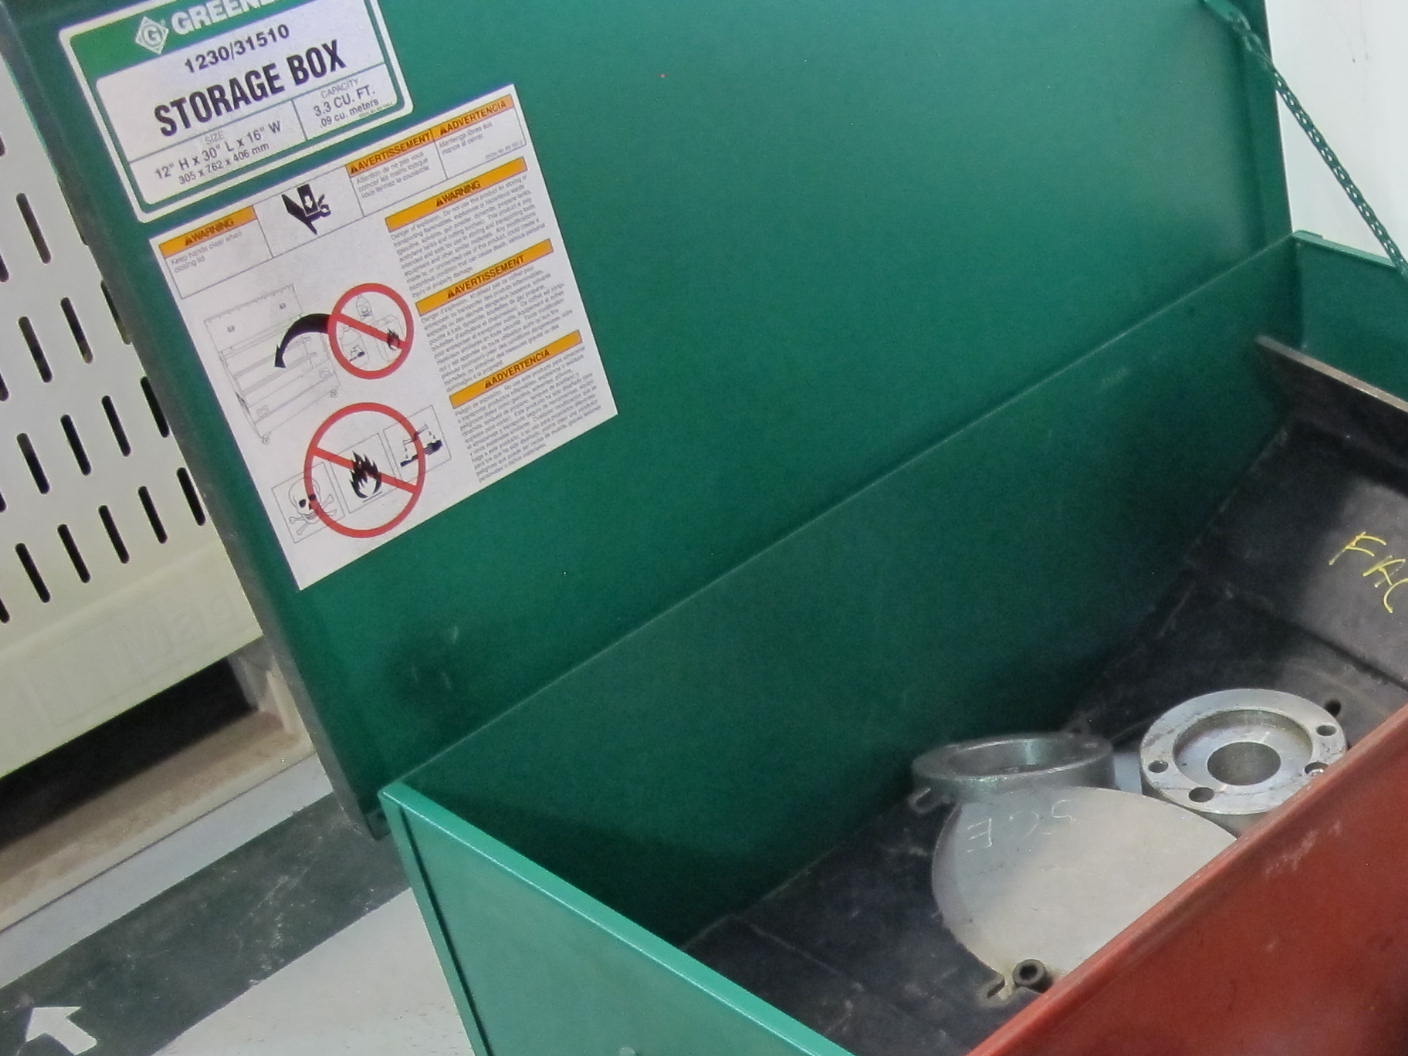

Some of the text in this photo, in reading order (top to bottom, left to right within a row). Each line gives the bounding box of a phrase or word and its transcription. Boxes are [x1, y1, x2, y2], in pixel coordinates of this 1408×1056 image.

[171, 0, 274, 35] GREEN
[184, 23, 290, 73] 1230/31510
[154, 39, 346, 137] STORAGE BOX
[313, 84, 376, 117] 3.3 CU. FT.
[321, 78, 358, 99] CAPACITY
[349, 98, 379, 116] meters
[447, 101, 507, 131] ADVERTENCIA
[155, 163, 174, 179] 12"
[178, 157, 190, 170] H
[201, 144, 221, 162] 30"
[224, 141, 234, 152] L
[247, 126, 265, 143] 16"
[268, 120, 281, 134] W
[204, 130, 225, 145] SIZE
[358, 132, 432, 170] AVERTISSEMENT
[178, 171, 197, 185] 305
[206, 160, 223, 174] 762
[233, 149, 250, 163] 406
[252, 142, 270, 155] mm
[442, 180, 481, 203] WARNING
[191, 217, 234, 242] WARNING
[454, 255, 525, 295] AVERTISSEMENT
[490, 349, 550, 385] ADVERTENCIA
